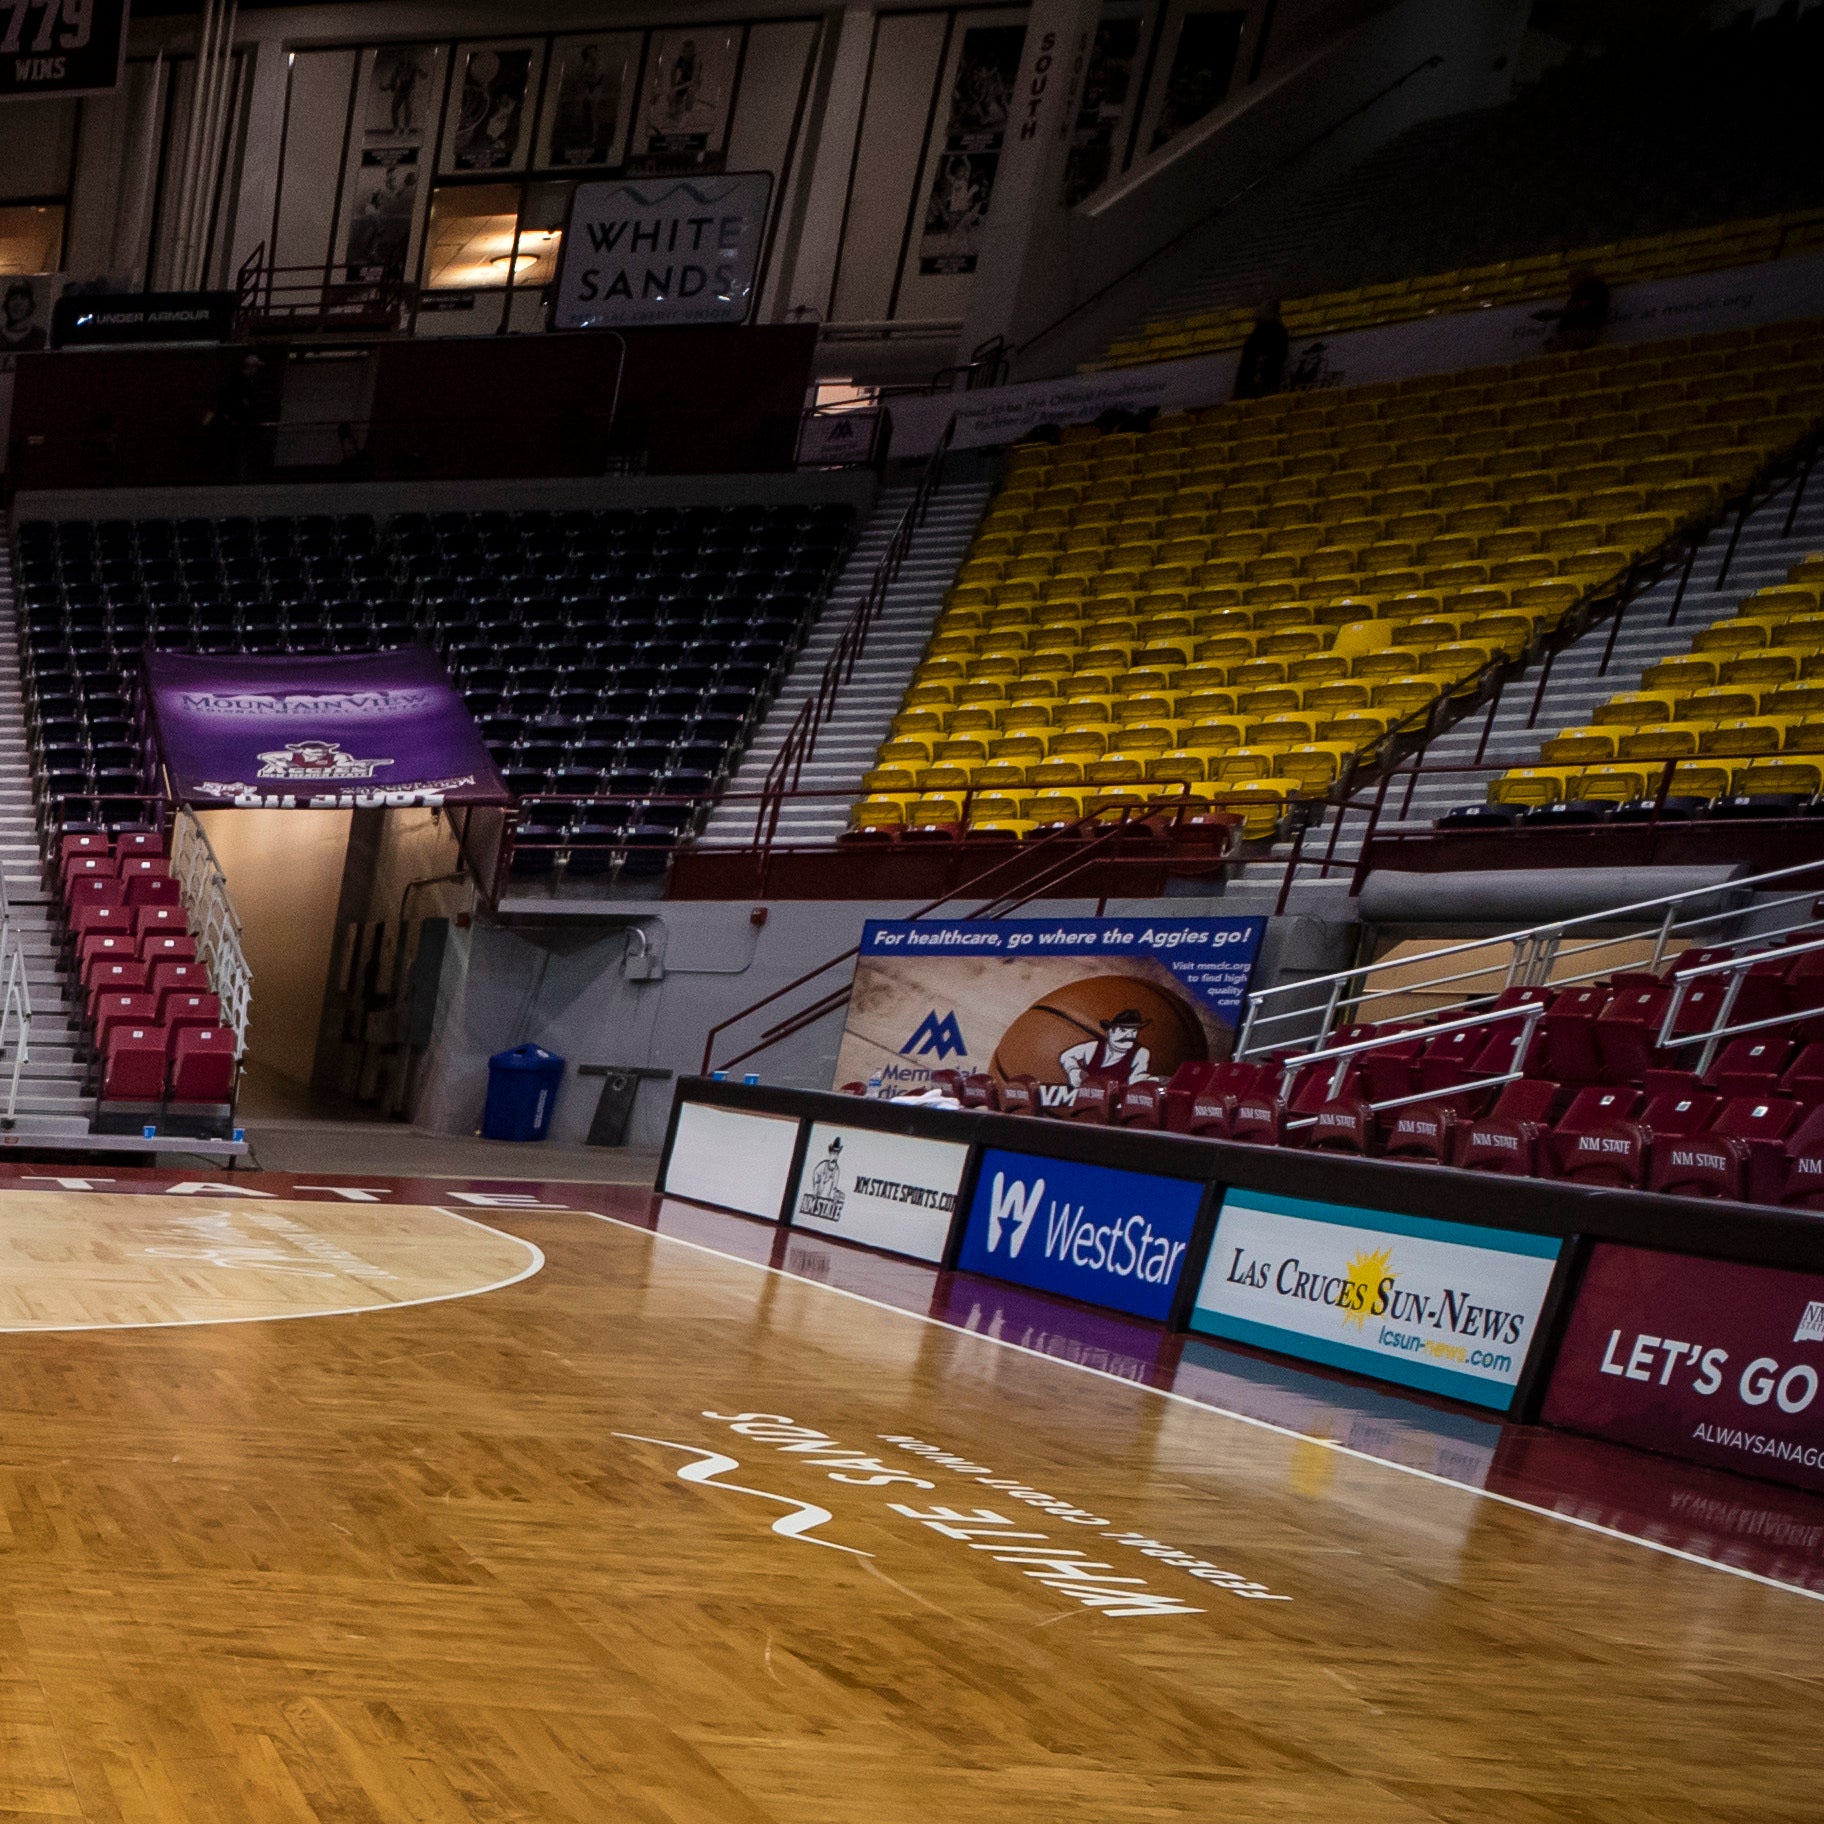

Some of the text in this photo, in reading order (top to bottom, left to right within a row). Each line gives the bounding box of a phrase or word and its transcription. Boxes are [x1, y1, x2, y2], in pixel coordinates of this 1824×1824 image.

[0, 0, 94, 53] 779
[15, 56, 67, 82] WINS
[1020, 32, 1055, 140] SOUTH
[588, 215, 744, 253] WHITE
[578, 264, 734, 302] SANDS
[96, 310, 210, 323] UNDER ARMOUR
[873, 928, 1251, 948] For healthcare, go where the Aggies go!
[1172, 962, 1195, 970] Visit
[1188, 973, 1248, 985] to find high
[1208, 986, 1244, 998] quality
[1319, 1114, 1356, 1129] NM STATE
[1398, 1120, 1437, 1137] NM STATE
[1472, 1133, 1518, 1150] NM STATE
[1579, 1137, 1630, 1155] NM STATE
[1673, 1151, 1726, 1171] NM STATE
[1798, 1158, 1822, 1173] NM
[815, 1198, 843, 1220] STATE
[1046, 1200, 1186, 1286] WestStar
[1226, 1247, 1524, 1346] LAS CRUCES SUN-NEWS
[1378, 1324, 1512, 1373] lcsun-news.com
[1601, 1329, 1818, 1414] LET'S GO
[701, 1411, 1209, 1617] WHITE SANDS
[876, 1434, 1293, 1601] FEDERAL CREDIT UNION
